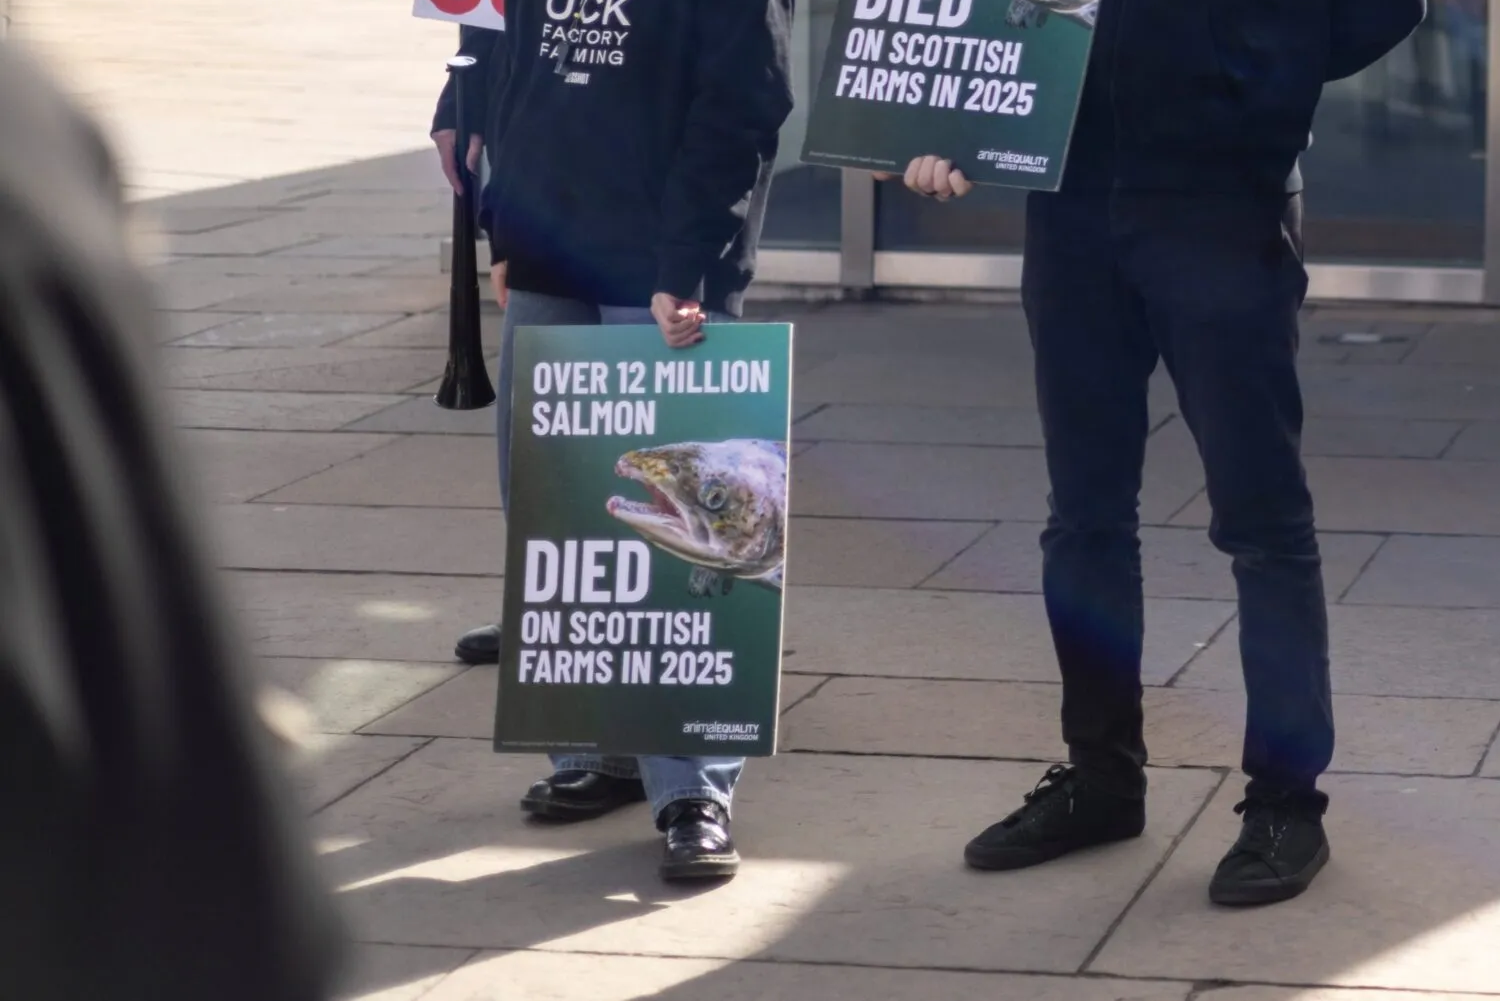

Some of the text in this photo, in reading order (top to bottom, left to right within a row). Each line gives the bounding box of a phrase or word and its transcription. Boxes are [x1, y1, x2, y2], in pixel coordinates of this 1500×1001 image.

[542, 23, 629, 46] FACTORY
[845, 27, 1023, 75] ON SCOTTISH
[539, 42, 624, 66] FAMING
[835, 64, 1037, 116] FARMS IN 2025
[977, 148, 1049, 165] animalEQUALITY
[1018, 165, 1047, 173] KINGDOM
[533, 359, 770, 395] OVER 12 MILLION
[532, 399, 656, 436] SALMON
[524, 539, 651, 603] DIED
[521, 610, 711, 646] ON SCOTTISH
[518, 649, 733, 685] FARMS IN 2025
[683, 721, 759, 733] animalEQUALITY
[704, 733, 759, 741] UNITED KINGDOM
